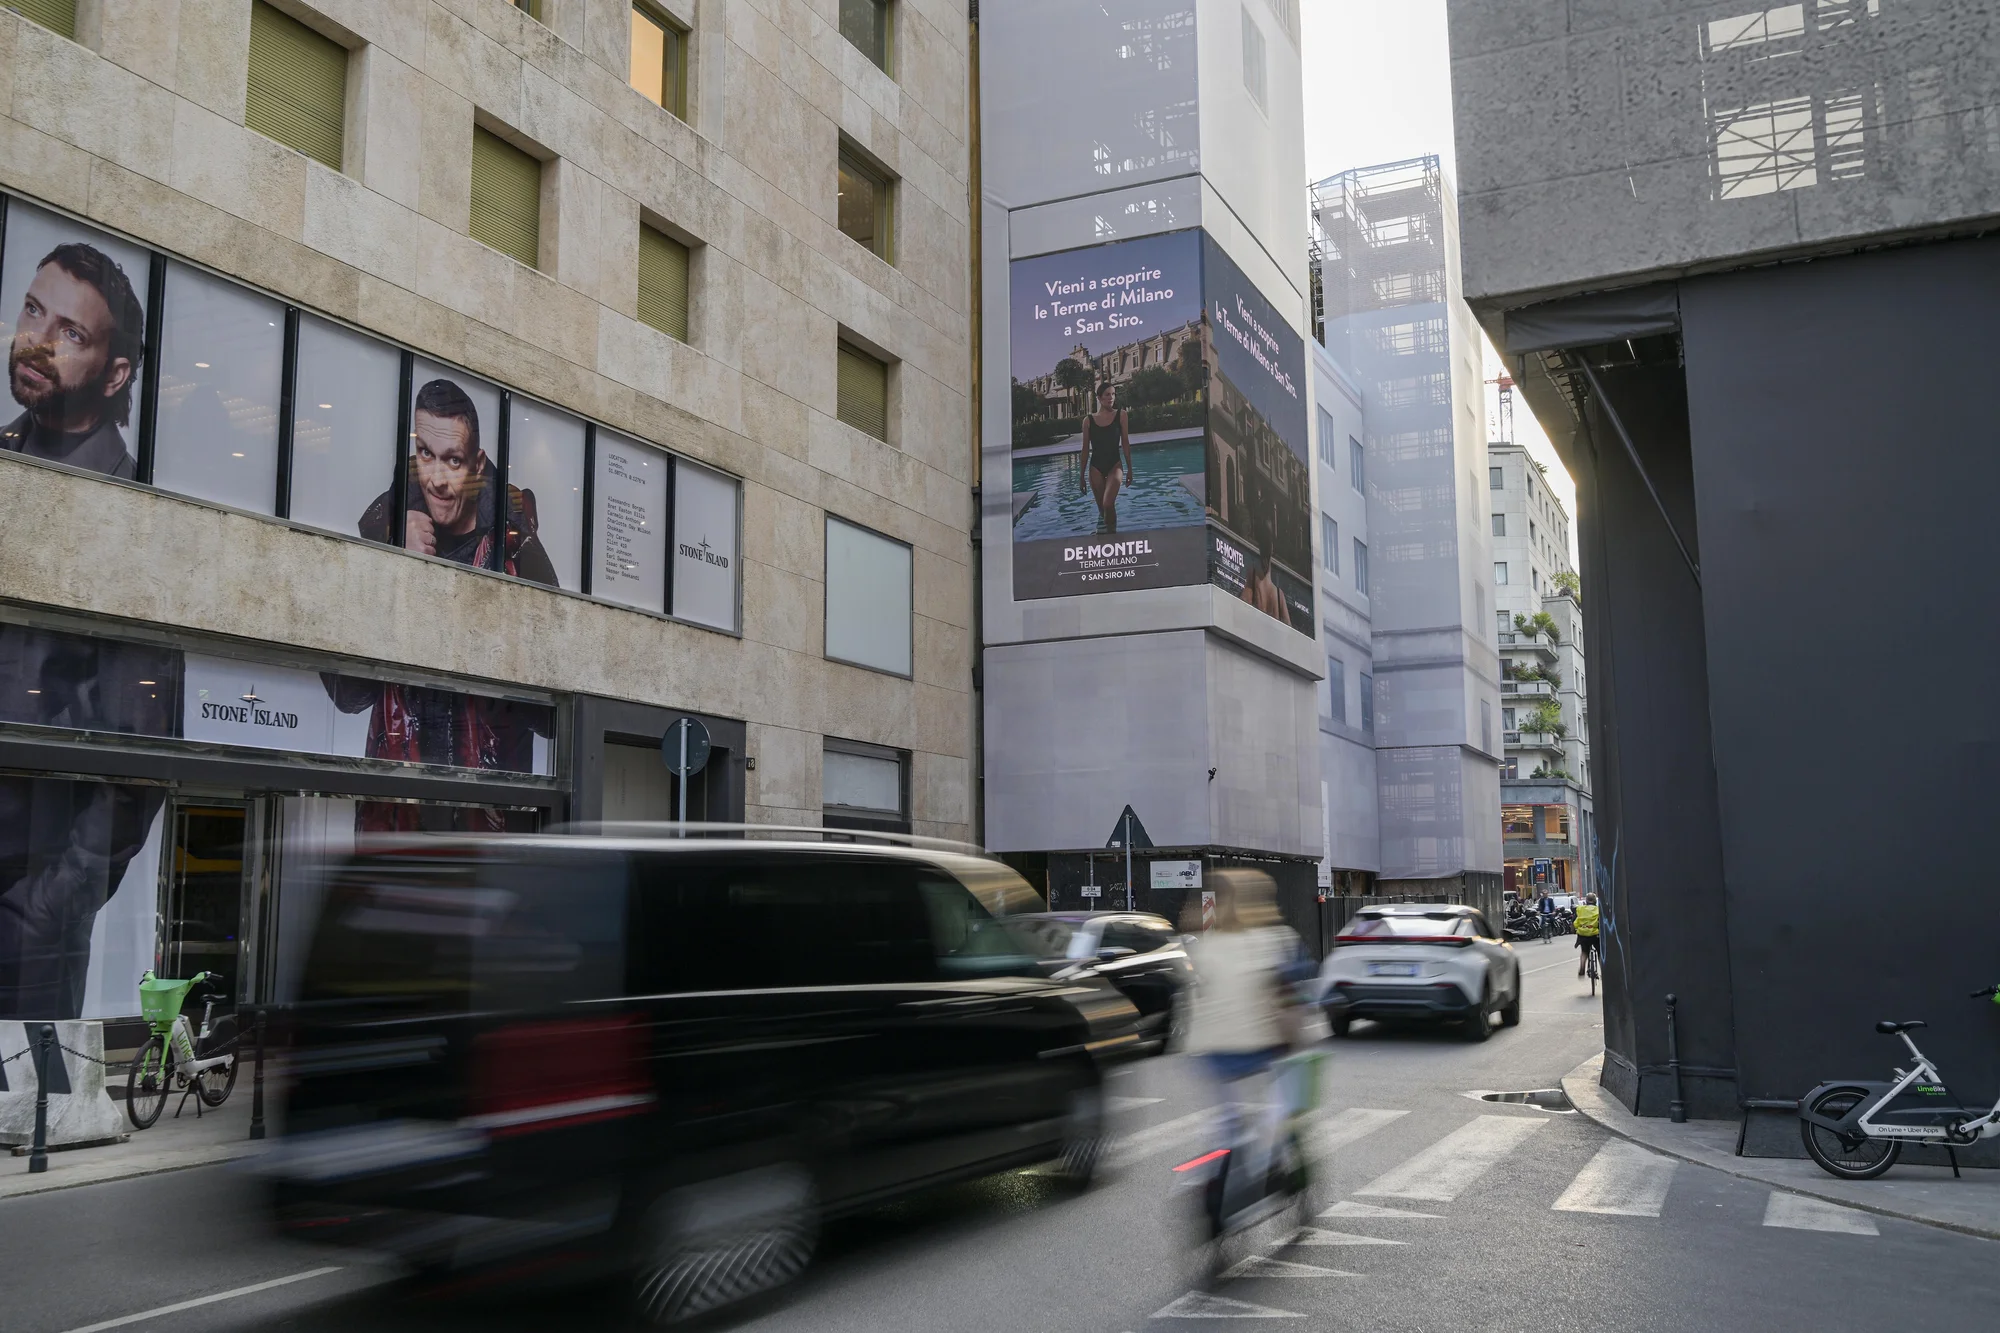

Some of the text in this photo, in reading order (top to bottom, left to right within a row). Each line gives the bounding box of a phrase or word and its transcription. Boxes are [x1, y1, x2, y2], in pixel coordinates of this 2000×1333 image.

[1045, 266, 1161, 296] Vieni a scoprire
[1035, 288, 1174, 320] le Terme di Milano
[1064, 313, 1144, 336] a San Siro.
[1236, 293, 1279, 354] Vieni a scoprire
[1216, 300, 1222, 323] le
[1223, 308, 1242, 343] Terme
[1243, 331, 1250, 351] di
[1250, 336, 1270, 371] Milano
[1274, 362, 1285, 386] San
[1285, 372, 1297, 399] Siro.
[680, 543, 729, 568] STONE ISLAND
[1080, 556, 1138, 569] TERME MILANO
[1088, 569, 1136, 581] SAN SIRO M5
[201, 702, 298, 729] STONE ISLAND
